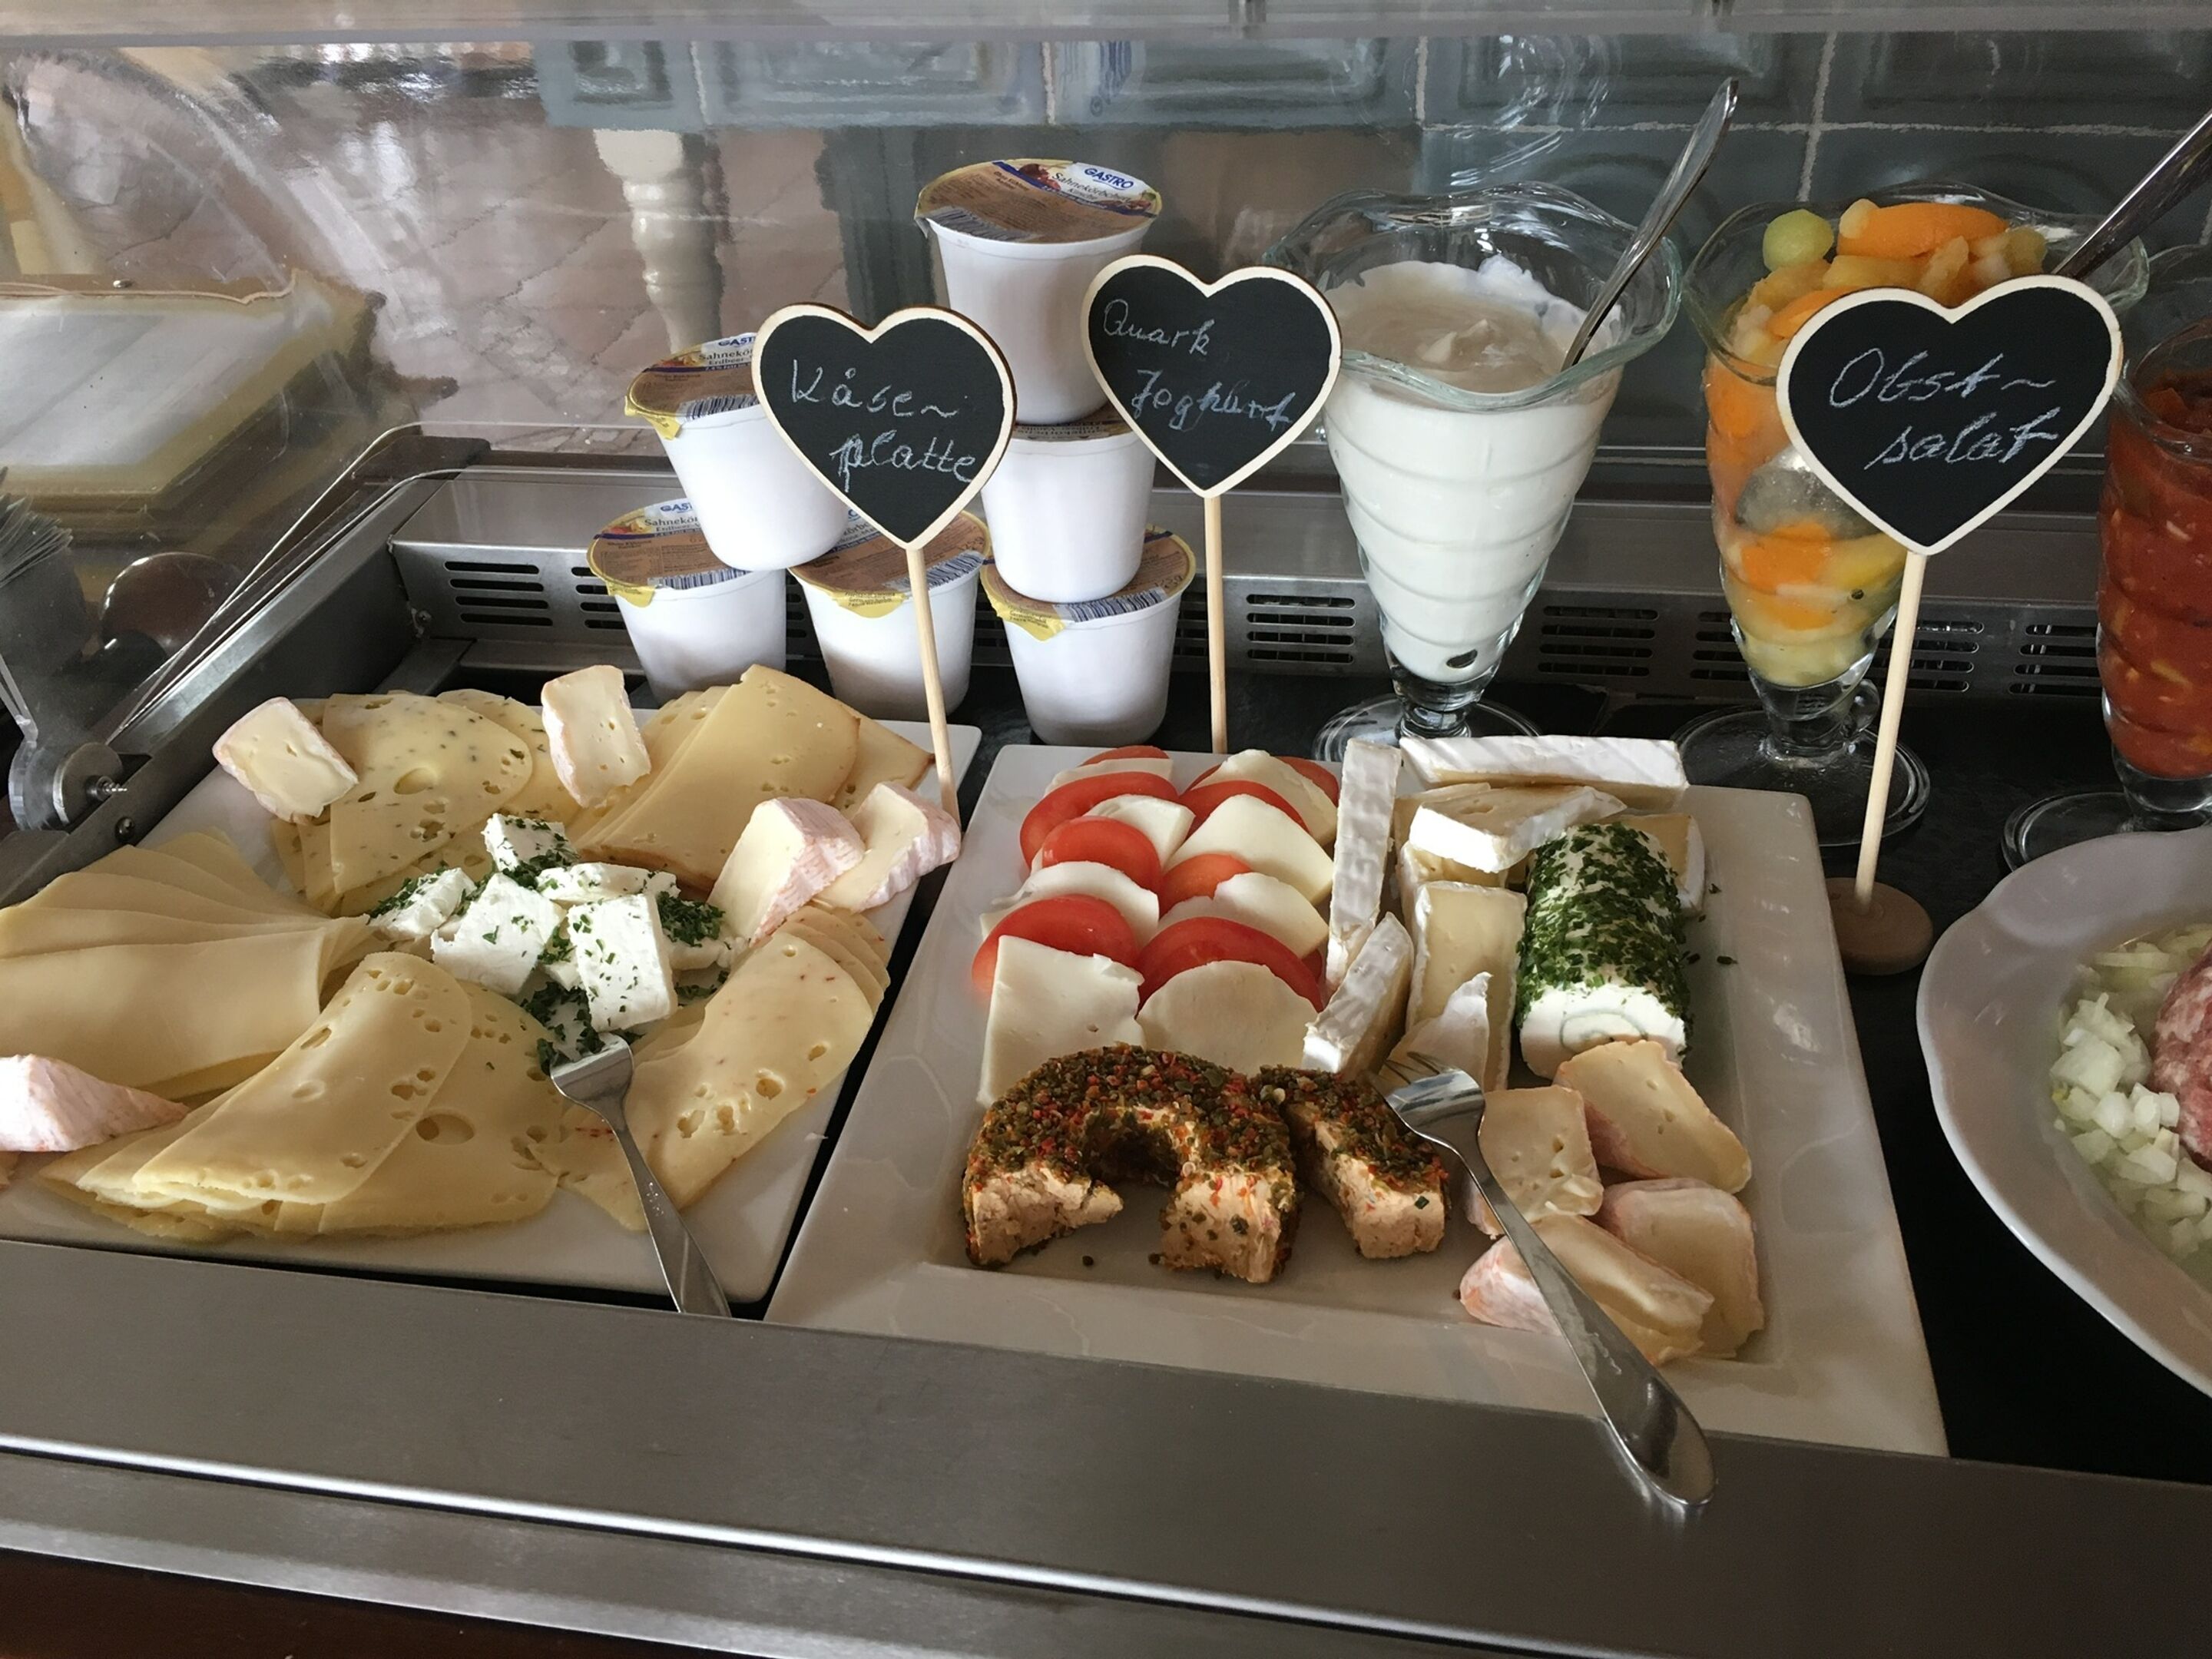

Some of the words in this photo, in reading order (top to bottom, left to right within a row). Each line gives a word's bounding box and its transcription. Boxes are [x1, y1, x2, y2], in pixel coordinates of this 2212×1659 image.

[1084, 167, 1134, 189] GASTRO
[1103, 298, 1216, 356] Quark
[829, 429, 976, 493] platte
[1863, 406, 2061, 471] salat
